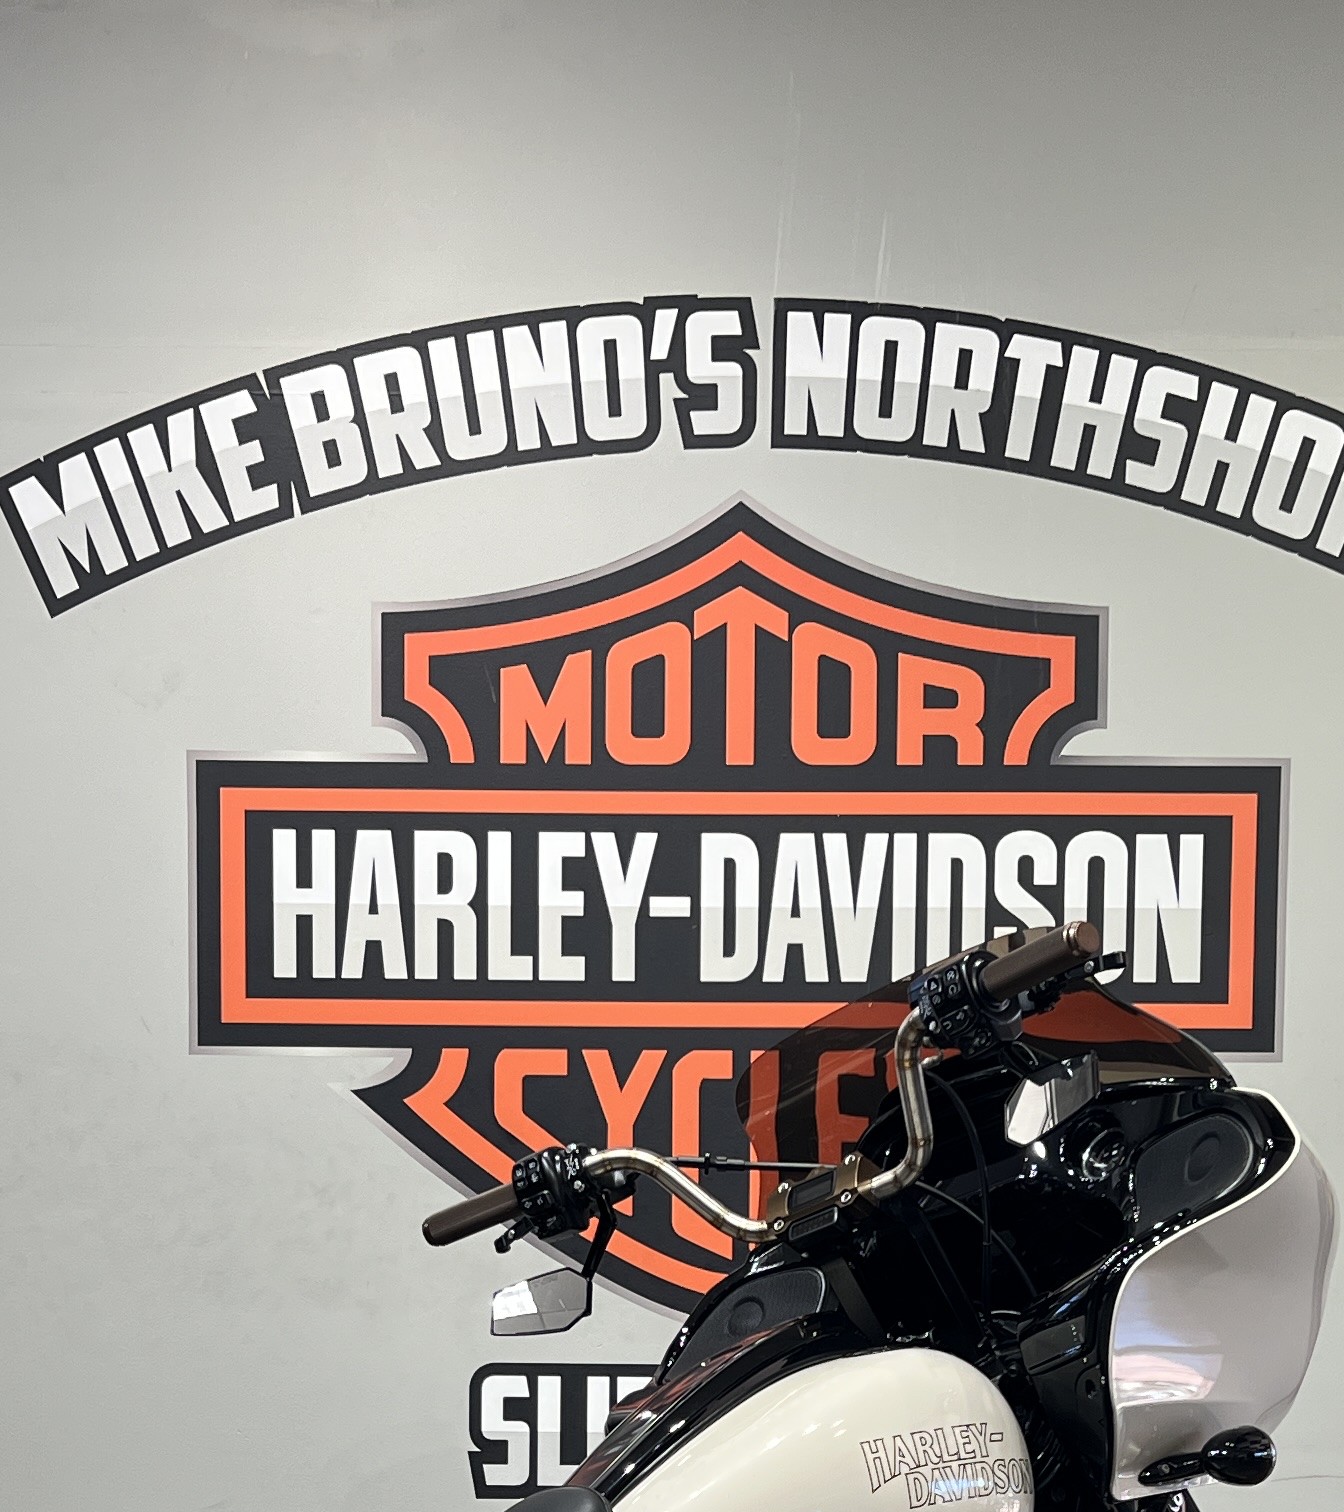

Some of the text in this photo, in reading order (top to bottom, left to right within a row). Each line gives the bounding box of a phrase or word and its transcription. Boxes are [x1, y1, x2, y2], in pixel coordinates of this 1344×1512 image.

[6, 387, 283, 601] MIKE
[278, 305, 744, 499] BRUNO'S
[498, 584, 986, 767] MOTOR
[271, 827, 1206, 985] HARLEY-DAVIDSON
[480, 1374, 654, 1488] SLI
[859, 1422, 1004, 1494] HARLEY-
[904, 1457, 1033, 1510] DAVIDSON
